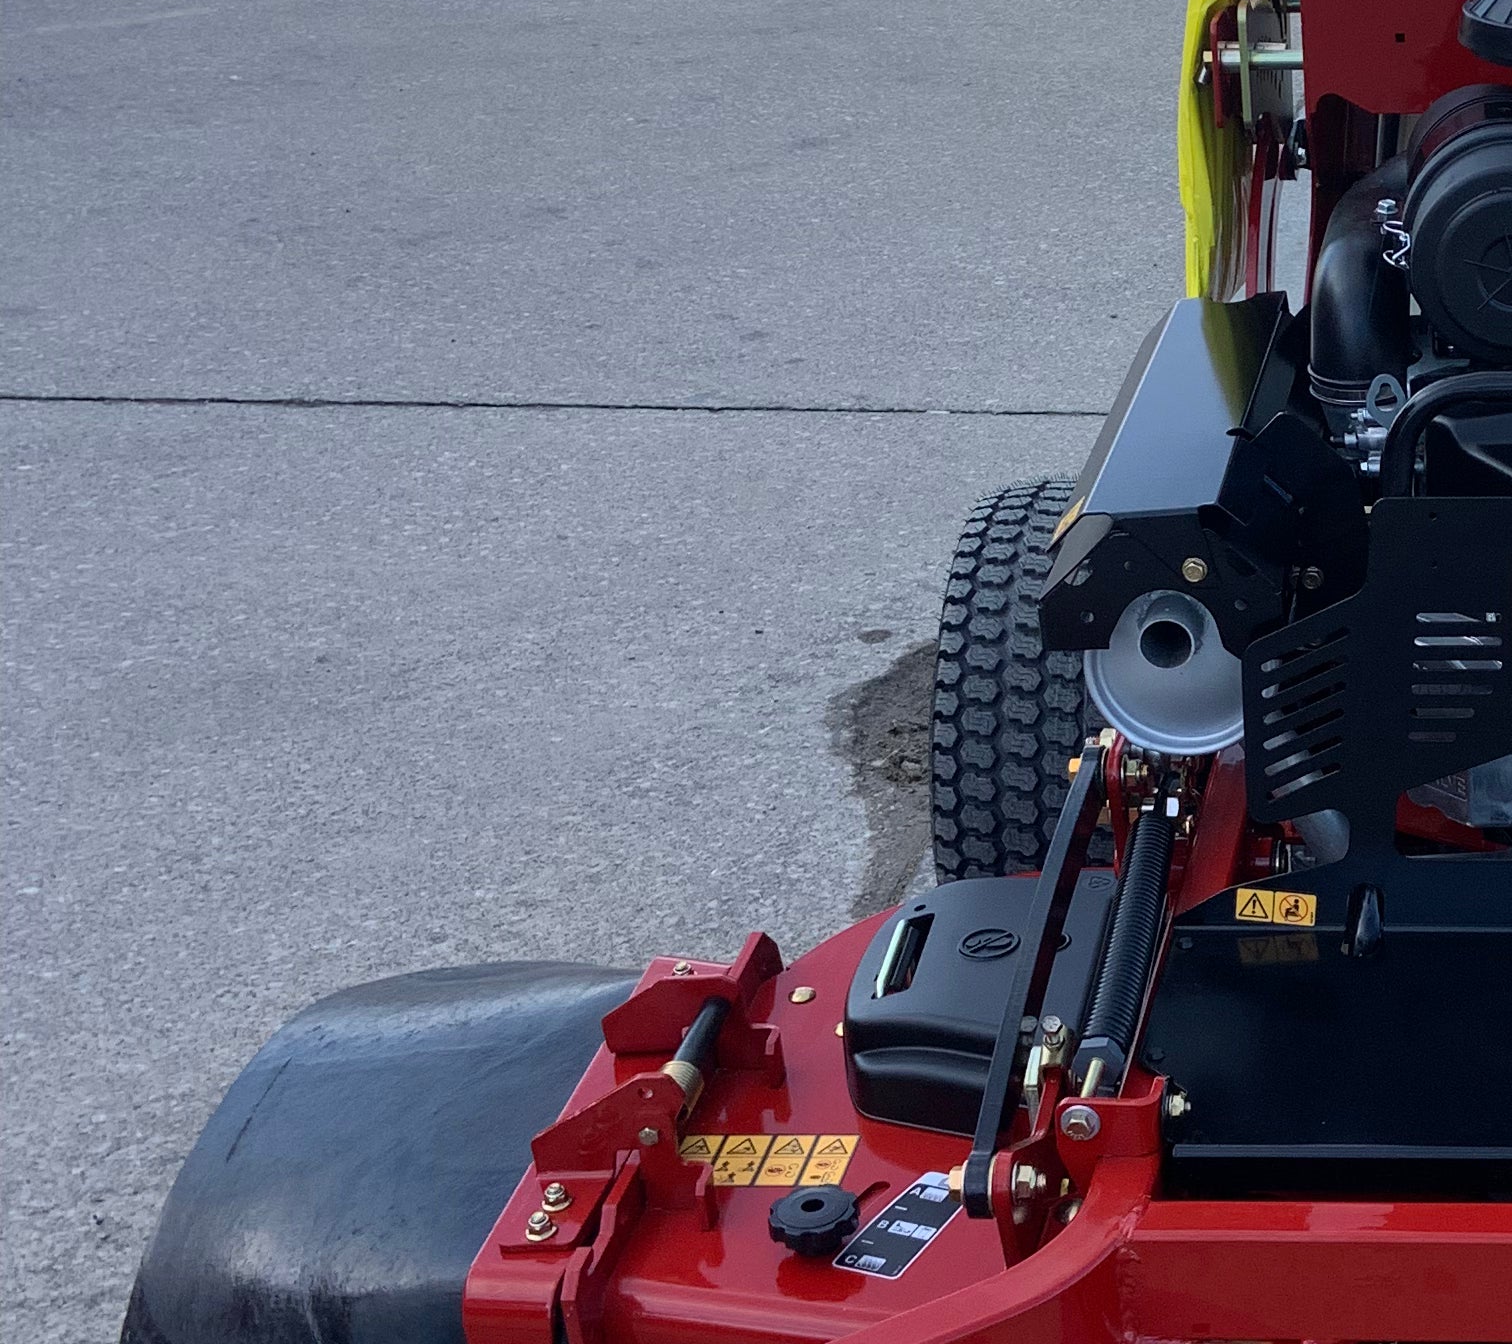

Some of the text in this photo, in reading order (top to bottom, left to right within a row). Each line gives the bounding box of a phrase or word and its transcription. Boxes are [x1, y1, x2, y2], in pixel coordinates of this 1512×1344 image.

[910, 1187, 921, 1196] A
[877, 1219, 889, 1229] B
[844, 1255, 858, 1264] C
